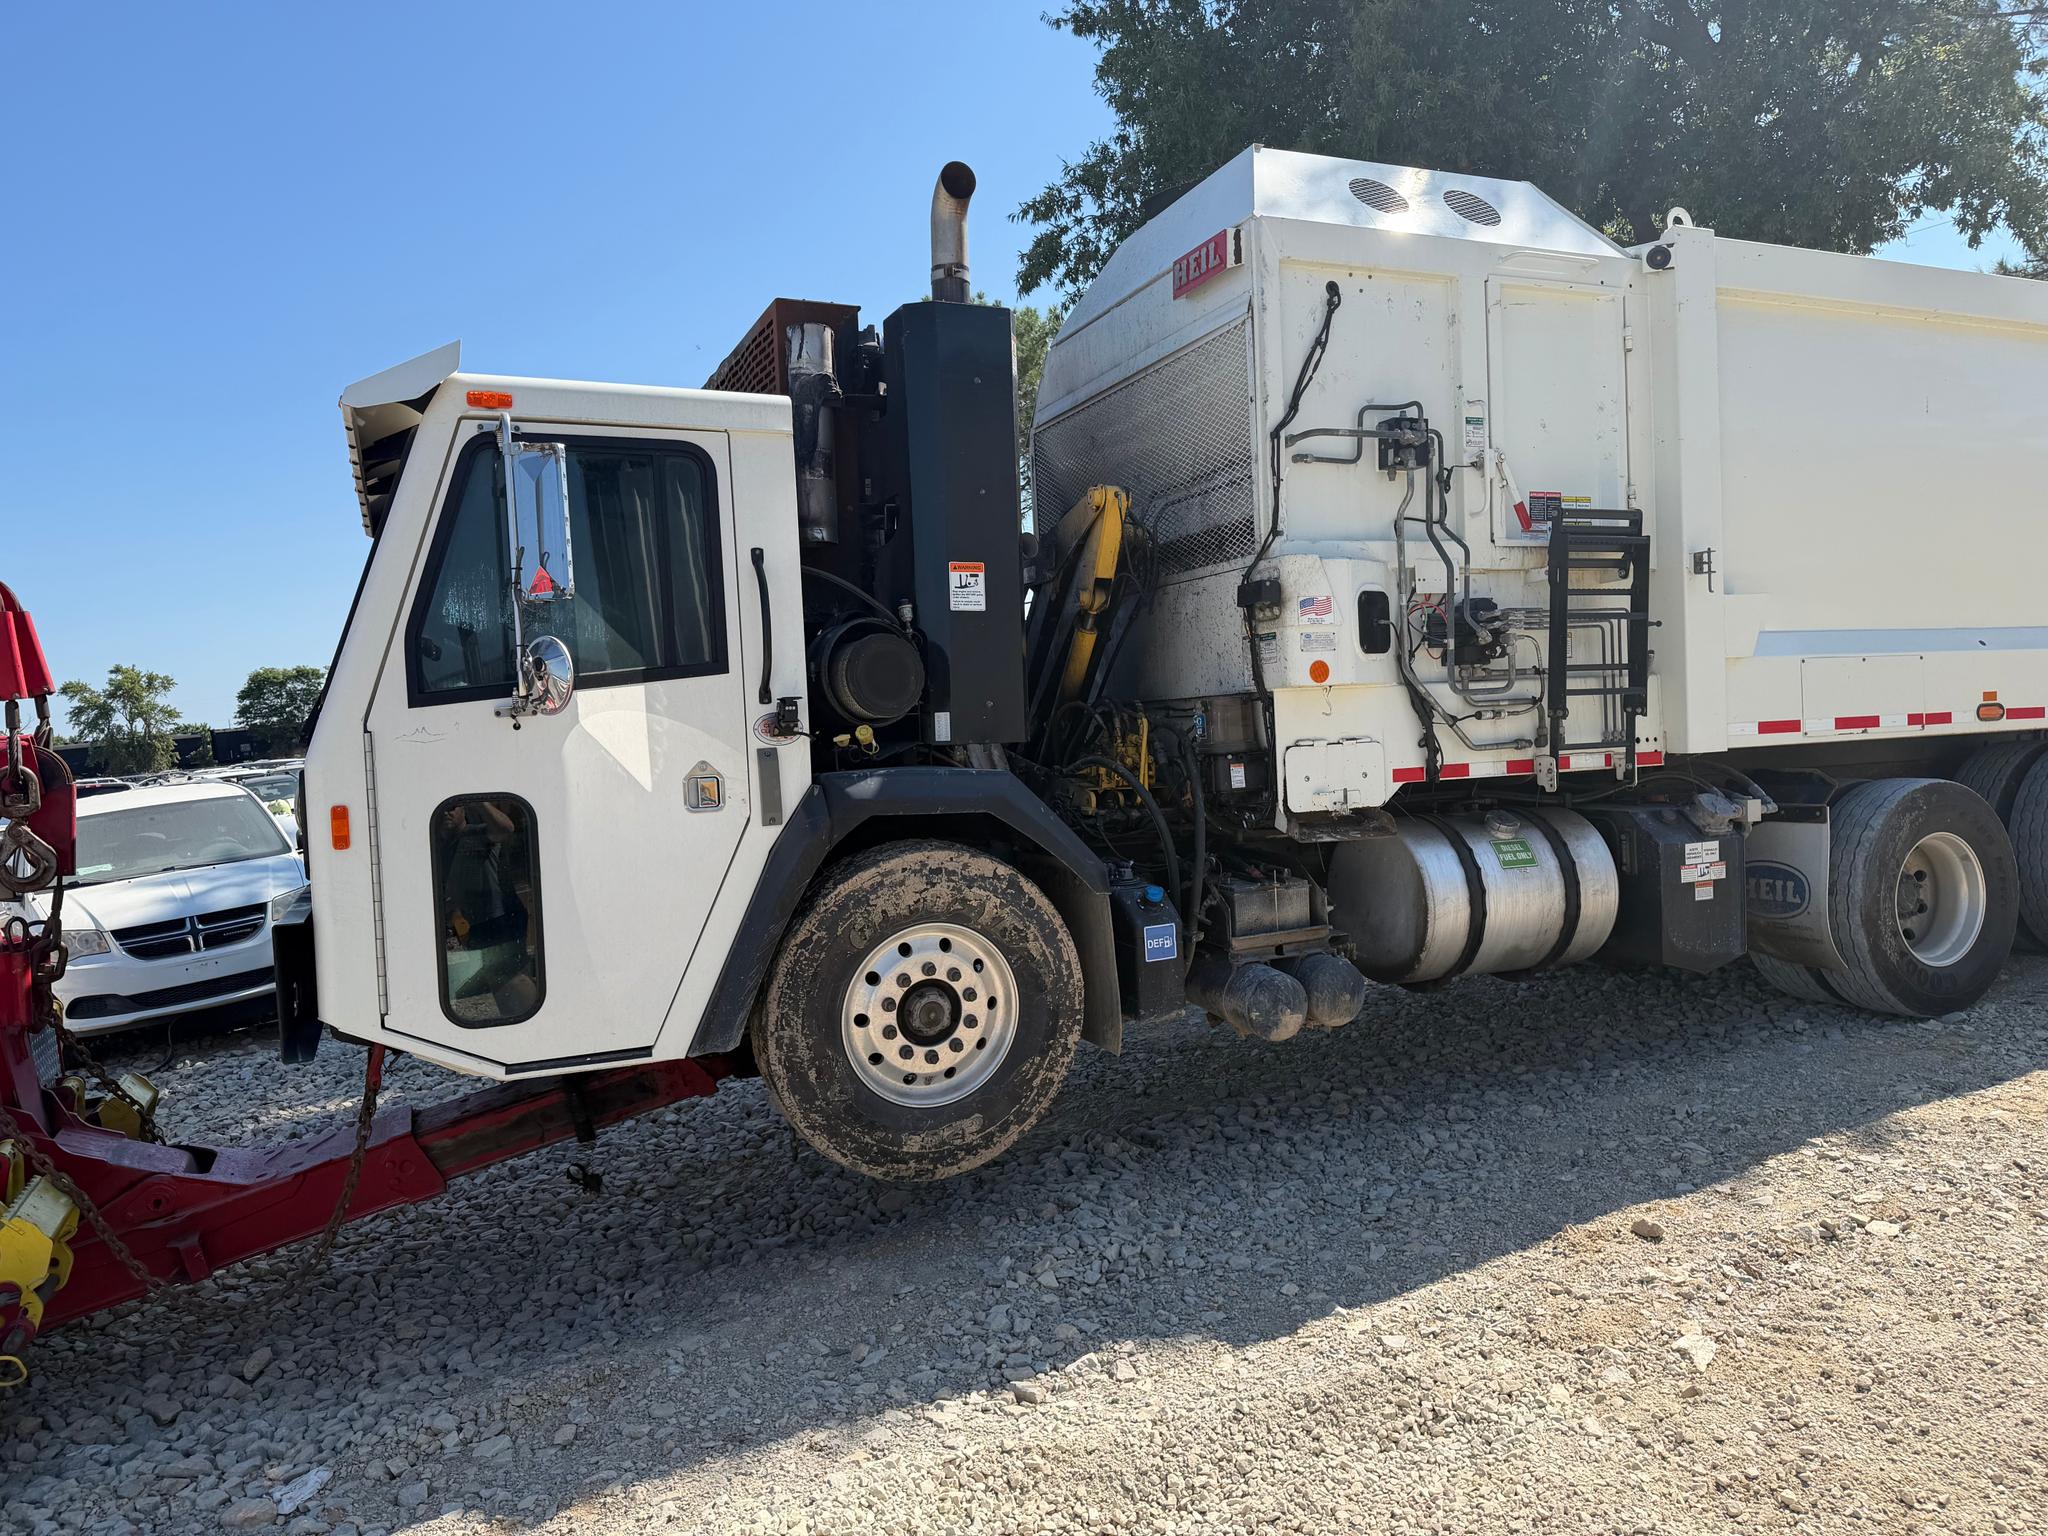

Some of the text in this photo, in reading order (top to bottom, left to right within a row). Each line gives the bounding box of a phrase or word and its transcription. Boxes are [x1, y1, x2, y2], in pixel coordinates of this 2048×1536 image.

[1174, 242, 1219, 289] HEIL
[1500, 843, 1523, 851] DIESEL
[1499, 851, 1533, 861] FUEL ONLY
[1147, 938, 1164, 949] DEF
